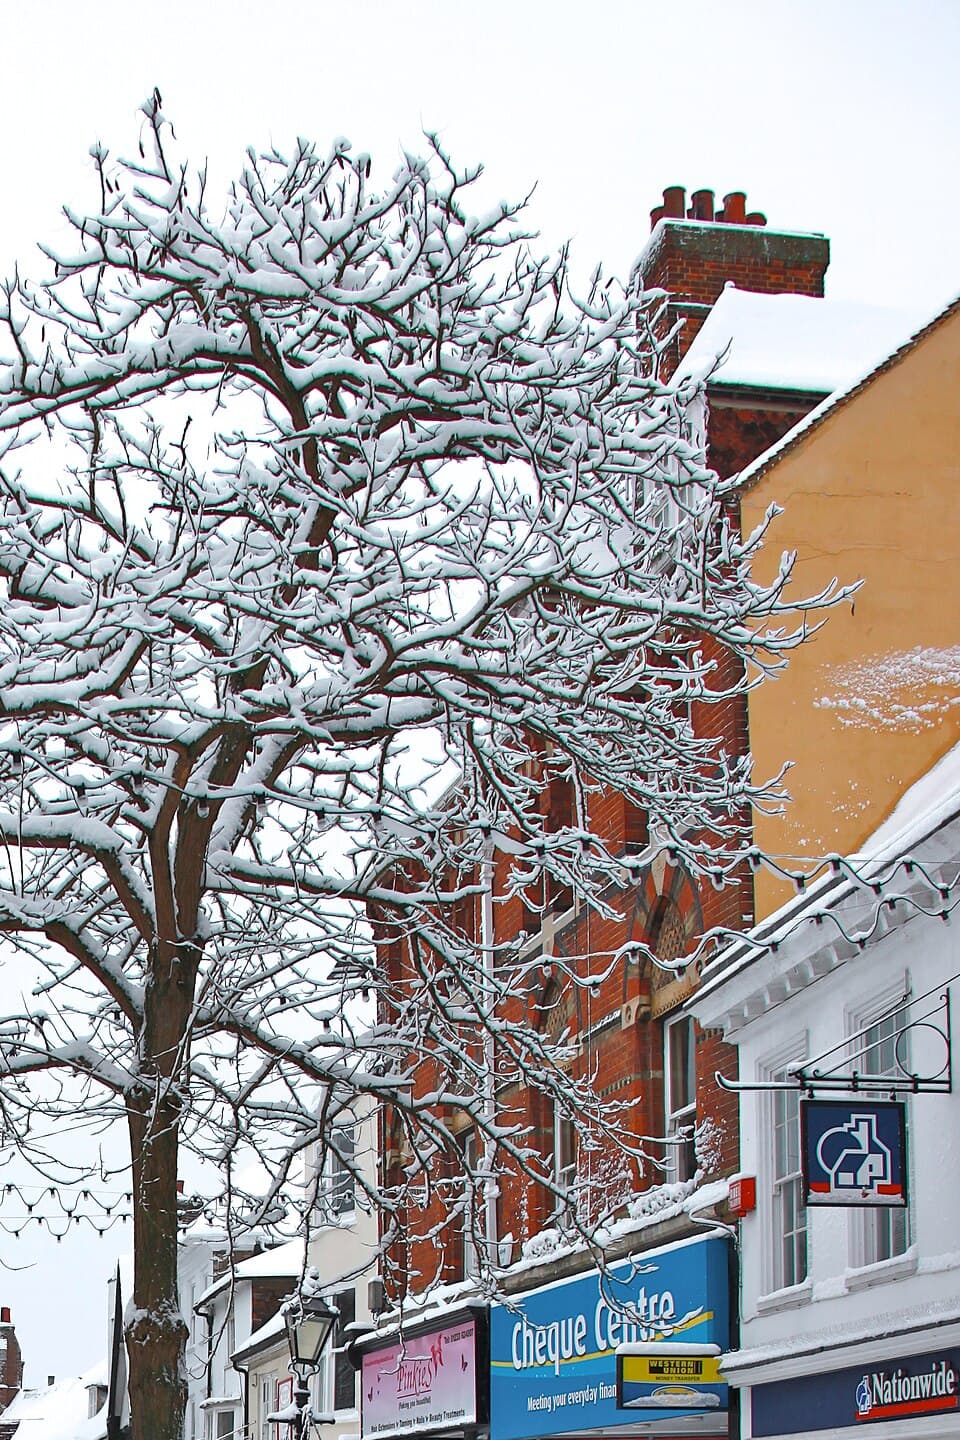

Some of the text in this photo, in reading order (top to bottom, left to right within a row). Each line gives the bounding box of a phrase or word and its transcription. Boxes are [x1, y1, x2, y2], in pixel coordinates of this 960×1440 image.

[512, 1286, 676, 1376] Cheque Centre
[649, 1360, 694, 1368] WESTERN
[527, 1393, 552, 1412] Meeting
[552, 1394, 568, 1411] your
[568, 1383, 598, 1407] everyday
[872, 1361, 955, 1405] Nationwide
